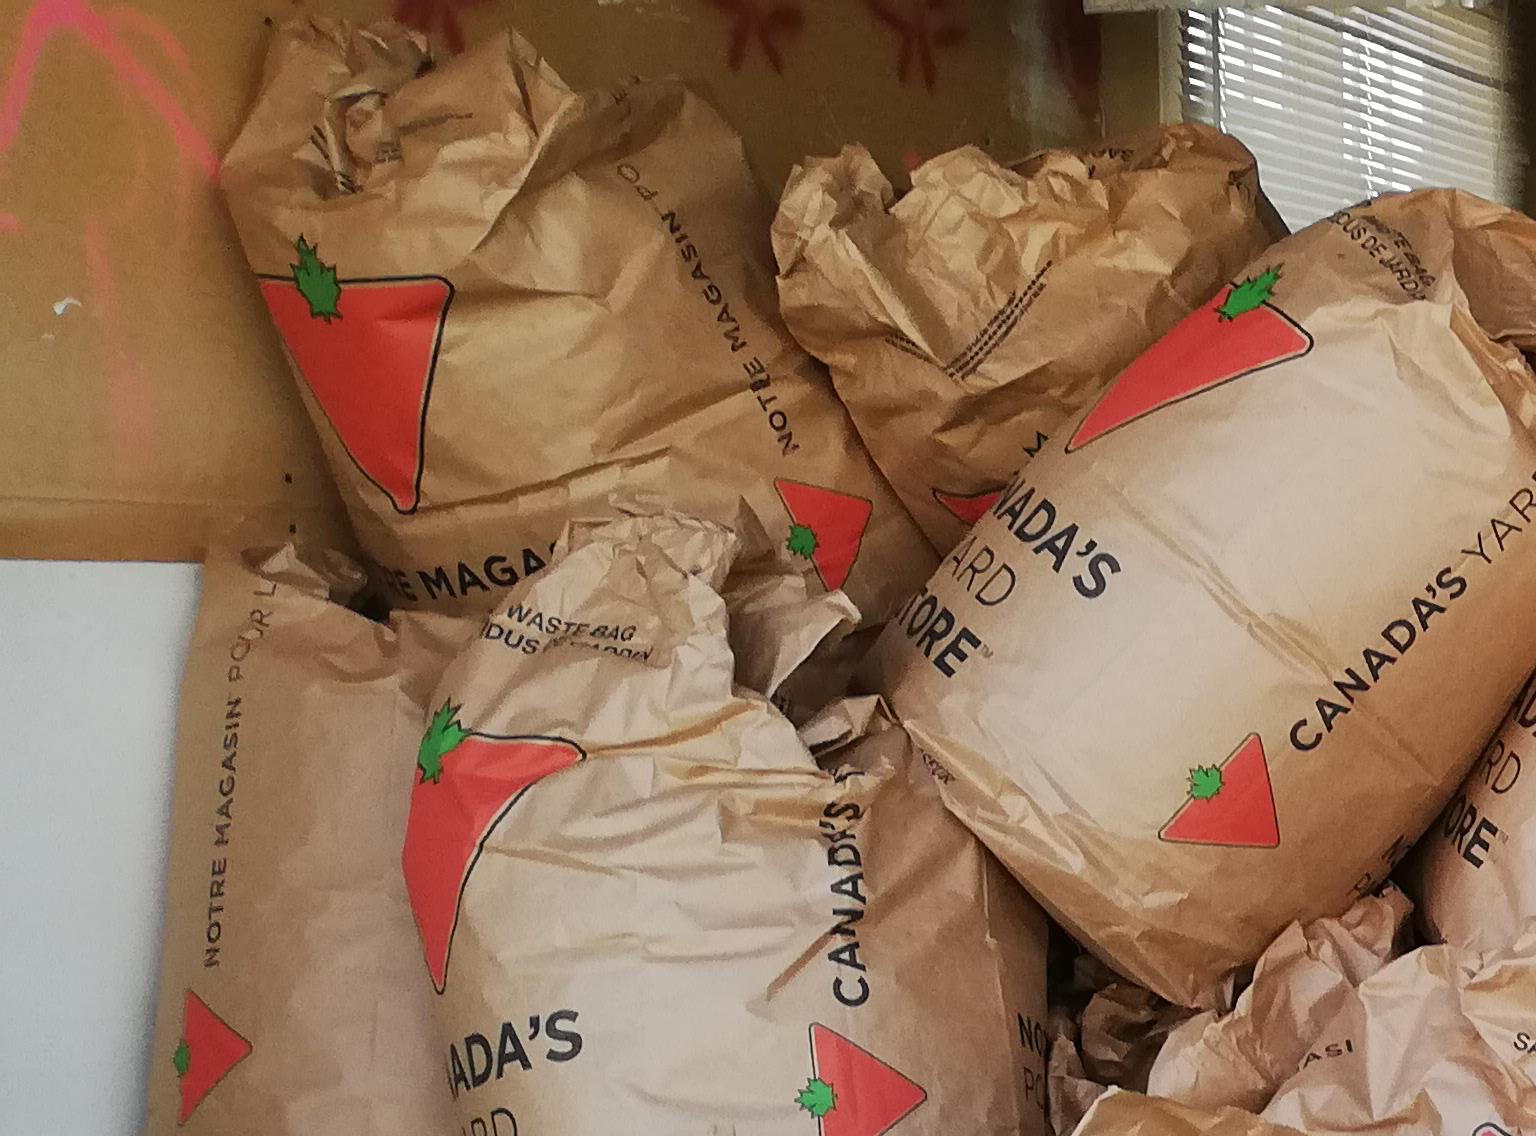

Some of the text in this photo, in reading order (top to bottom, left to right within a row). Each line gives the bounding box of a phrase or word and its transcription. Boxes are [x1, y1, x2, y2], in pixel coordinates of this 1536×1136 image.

[661, 210, 747, 353] MAGASIN
[743, 356, 800, 456] NOTRE
[416, 542, 558, 600] MAGA
[944, 535, 1017, 607] ARD
[227, 608, 274, 684] POUR
[507, 604, 589, 642] WASTE
[1290, 567, 1467, 751] CANADA'S
[213, 697, 242, 848] MAGASIN
[1443, 796, 1498, 869] ORE
[204, 858, 226, 968] NOTRE
[448, 1009, 583, 1099] ADA'S
